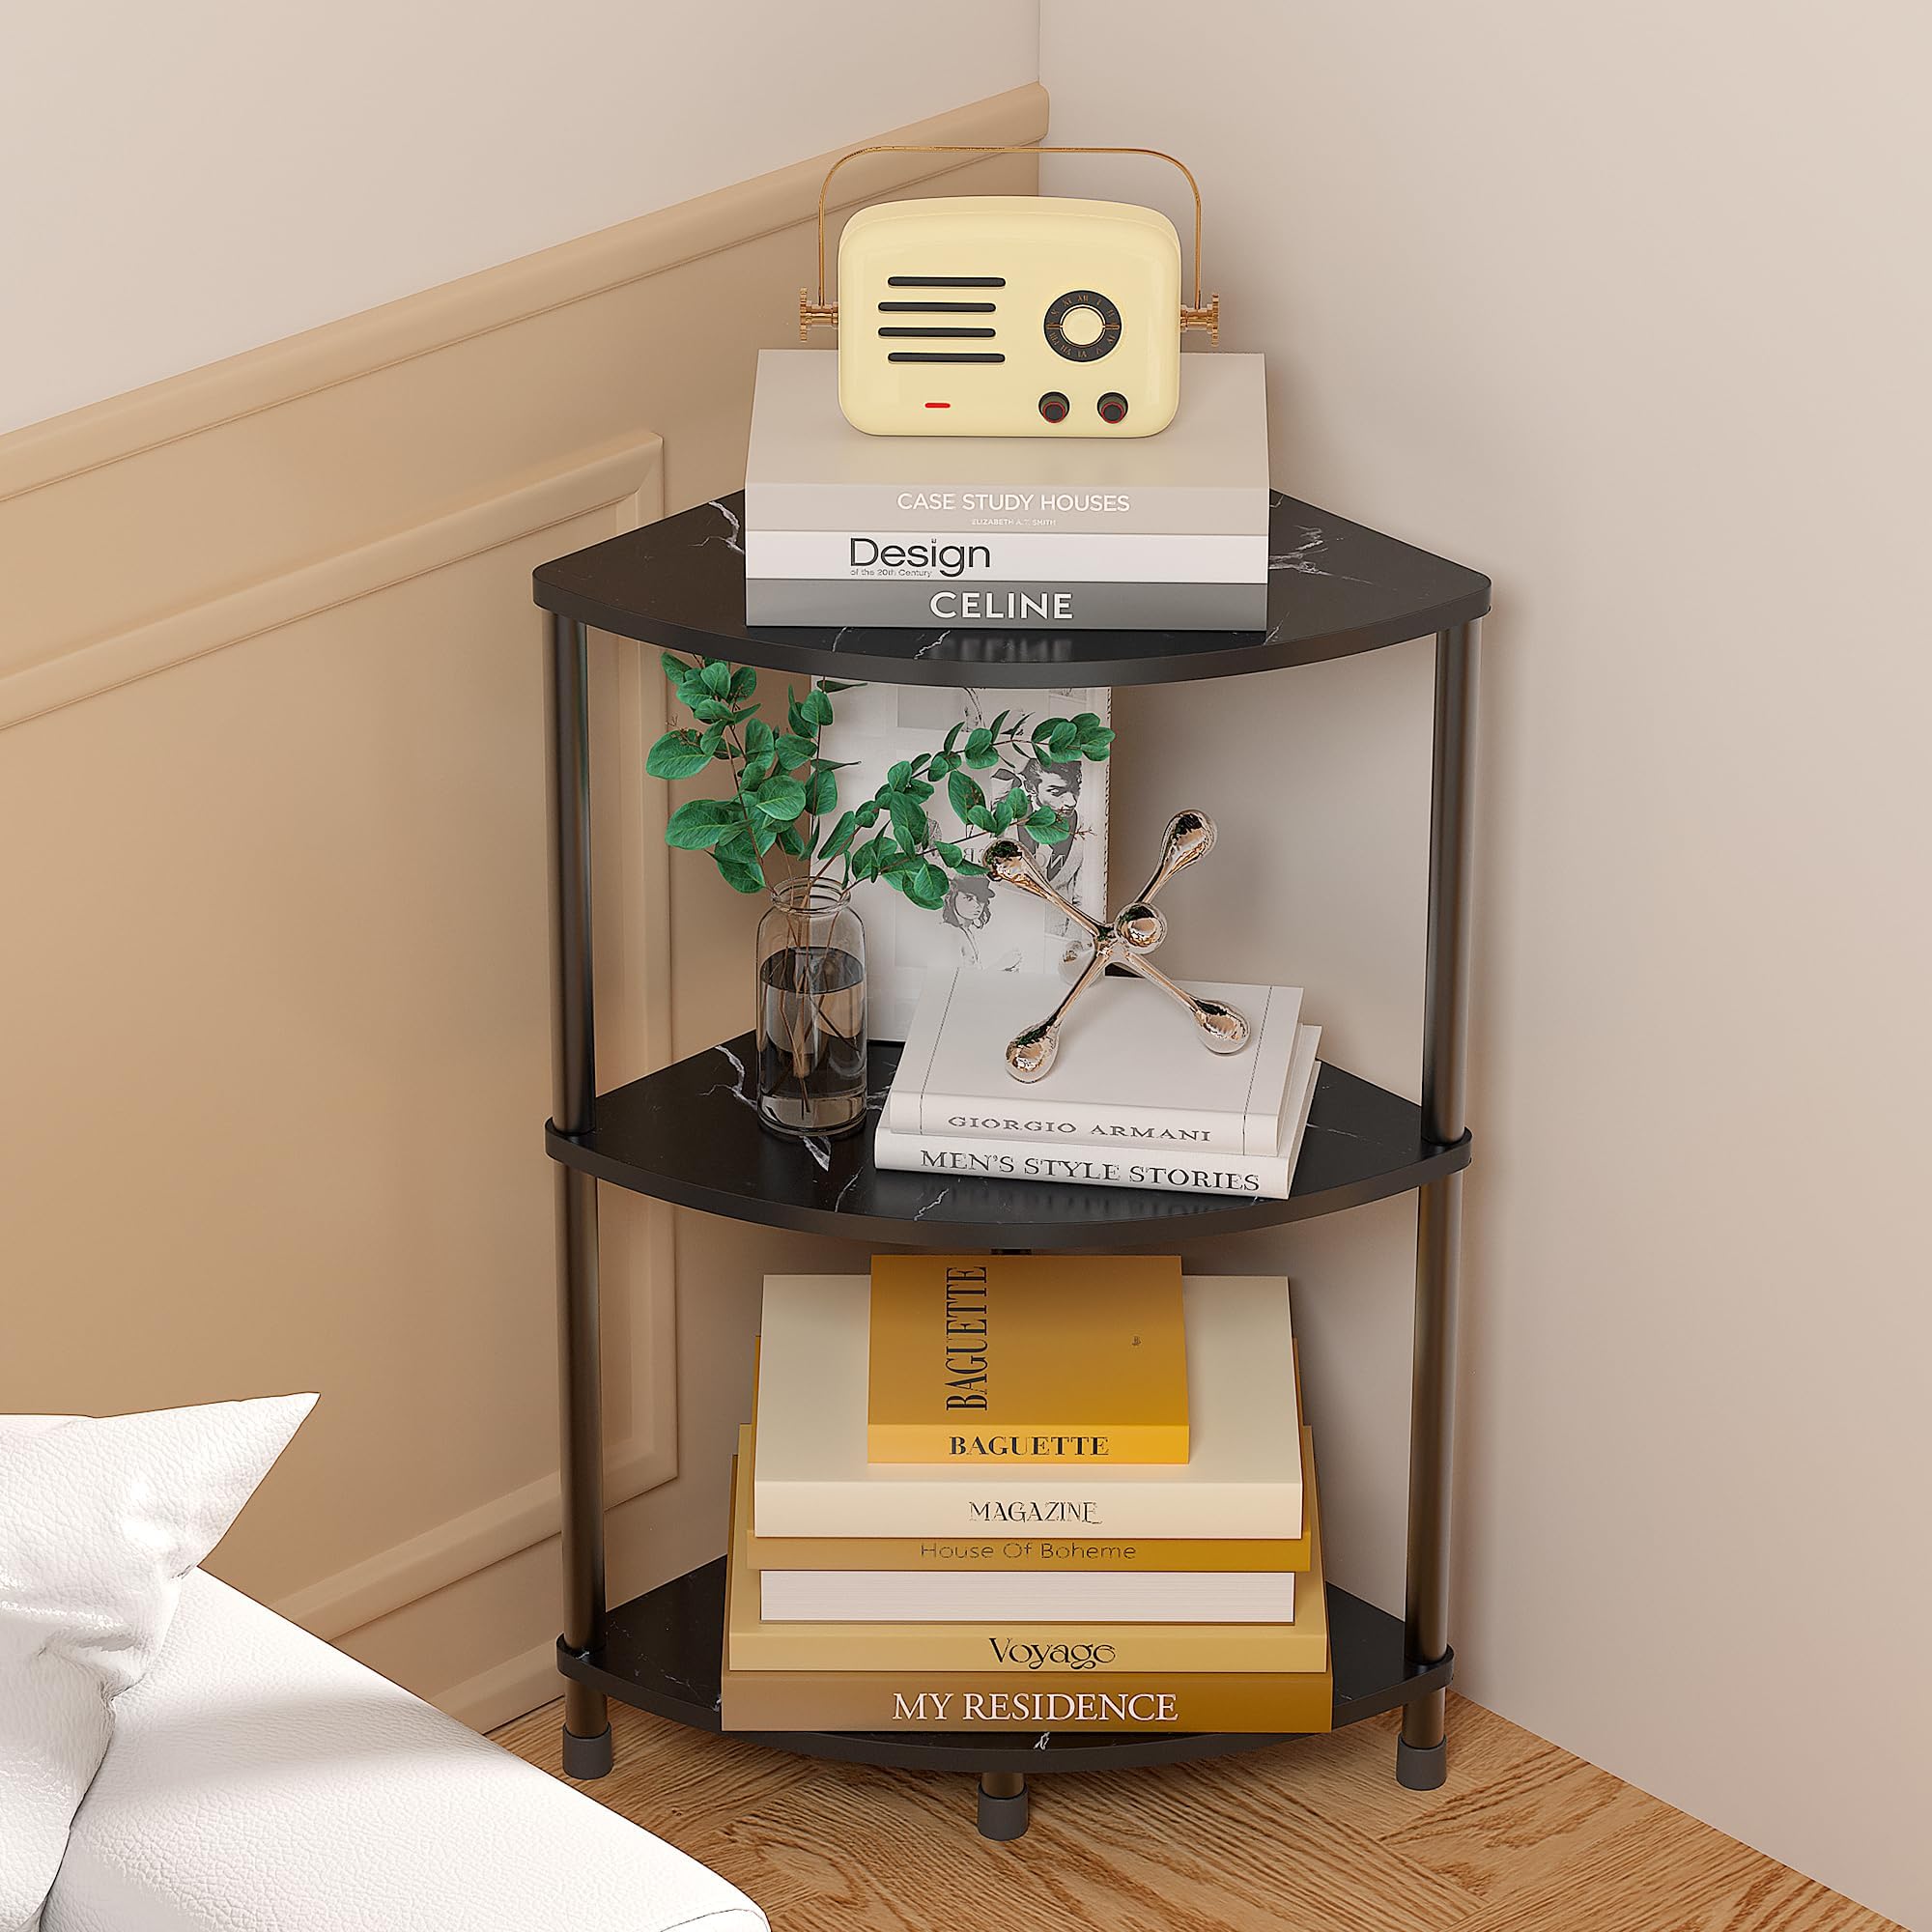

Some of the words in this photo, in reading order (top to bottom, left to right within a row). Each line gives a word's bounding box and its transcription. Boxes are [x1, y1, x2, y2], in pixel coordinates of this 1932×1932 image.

[897, 493, 956, 510] CASE
[963, 493, 1034, 511] STUDY
[1041, 494, 1130, 512] HOUSES
[850, 537, 990, 578] Design
[898, 568, 932, 578] Century
[929, 591, 1073, 619] CELINE
[947, 1116, 1077, 1134] GIORGIO
[1089, 1124, 1211, 1142] ARMANI
[920, 1149, 1015, 1173] MEN'S
[1024, 1157, 1120, 1182] STYLE
[1128, 1165, 1260, 1191] STORIES
[945, 1265, 988, 1411] BAGUETTE
[949, 1435, 1110, 1456] BAGUETTE
[968, 1501, 1103, 1524] MAGAZINE
[921, 1542, 994, 1559] House
[1003, 1542, 1033, 1559] Of
[1040, 1542, 1137, 1560] Boheme
[988, 1637, 1117, 1670] Voyage
[892, 1692, 954, 1721] MY
[962, 1692, 1179, 1721] RESIDENCE
